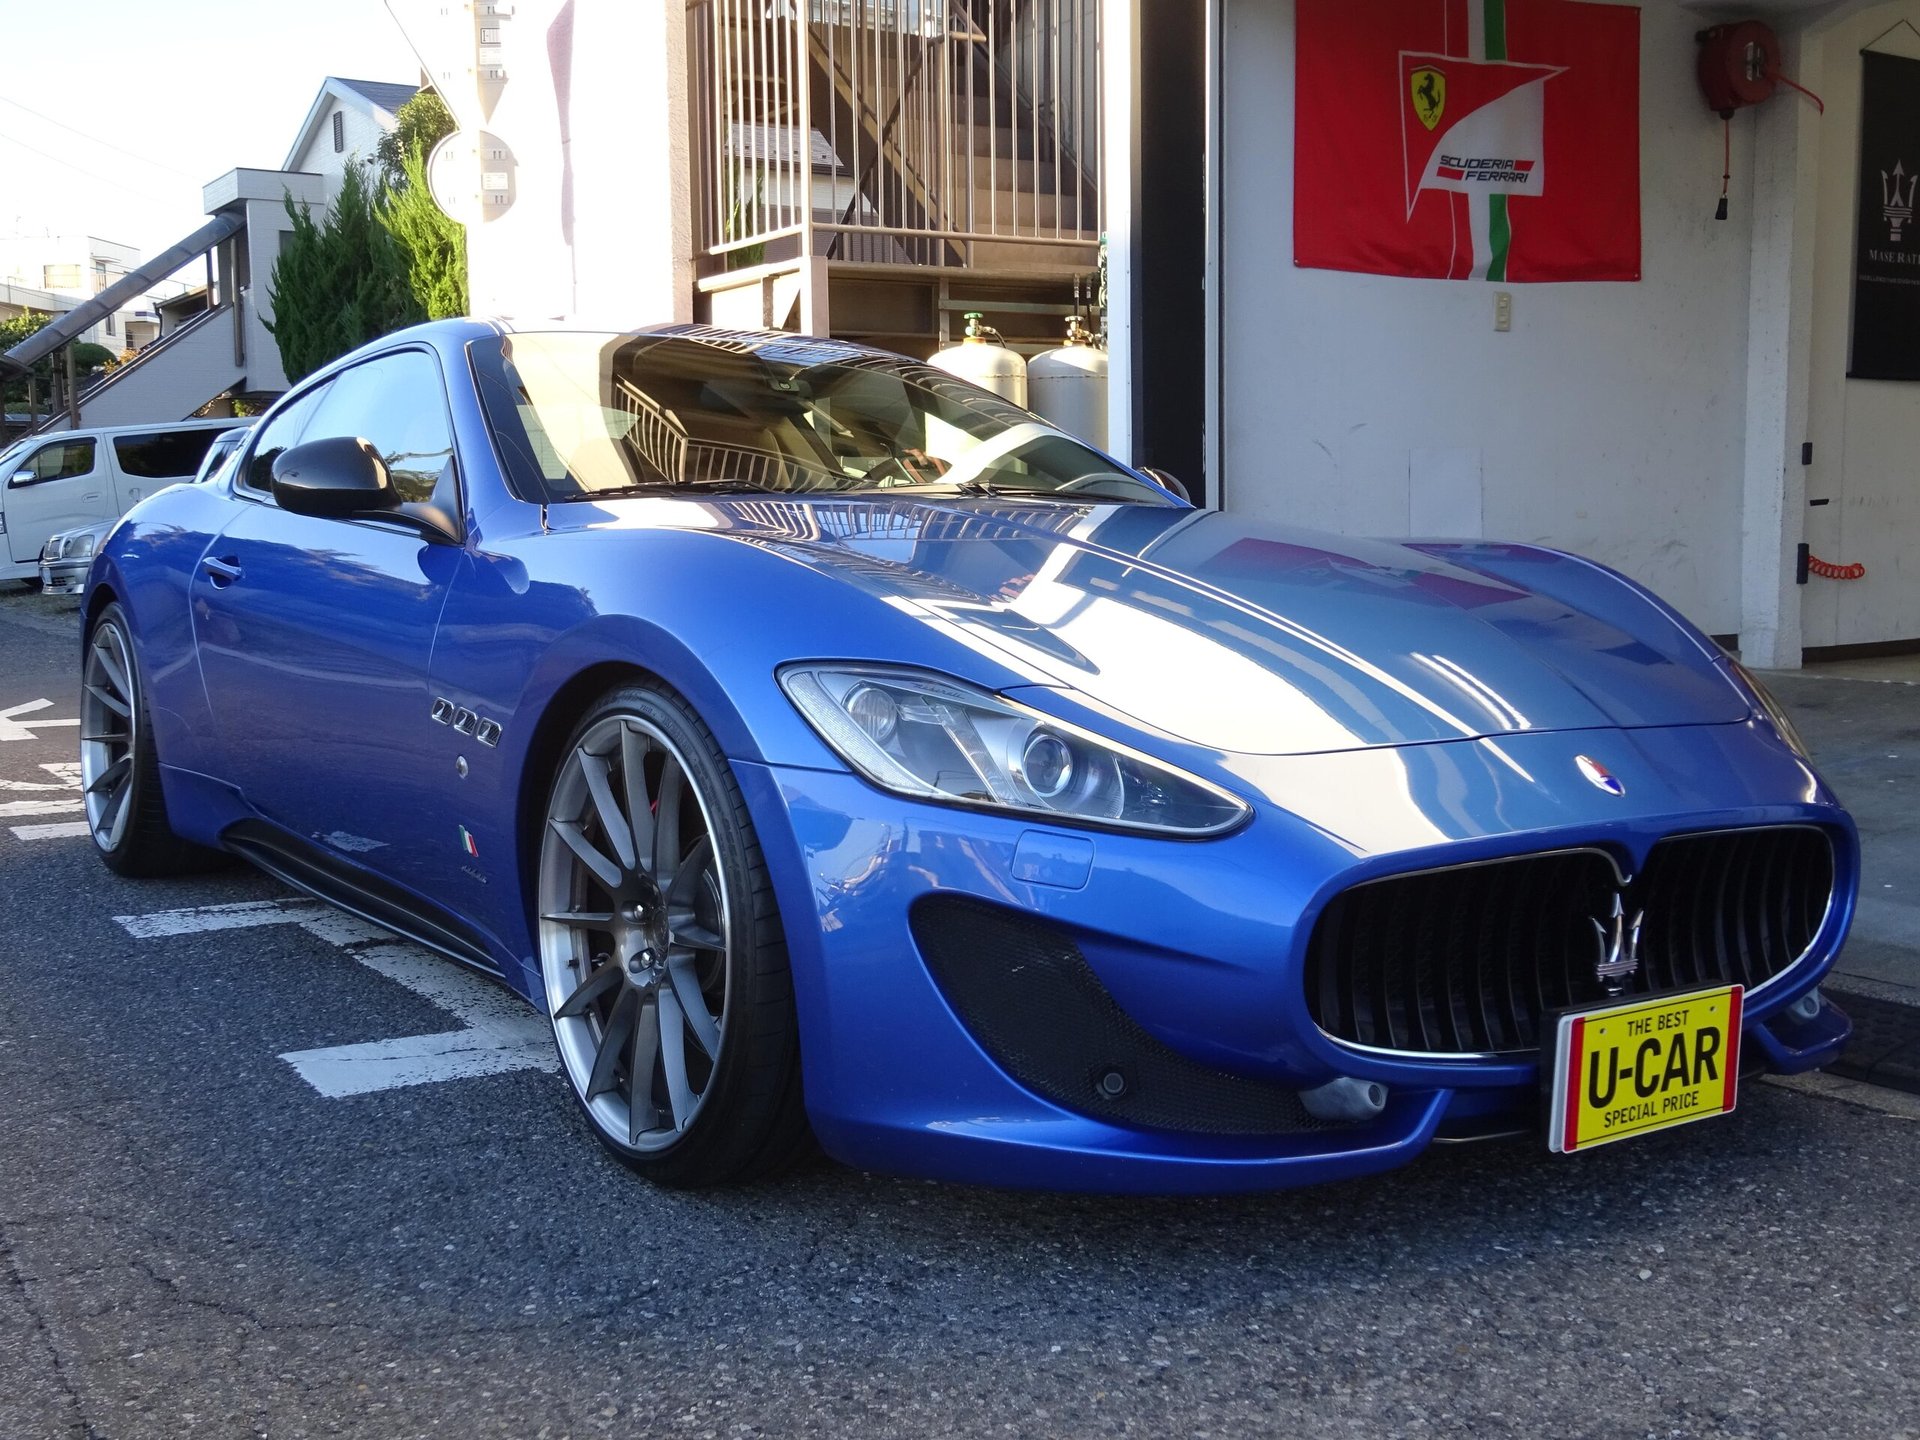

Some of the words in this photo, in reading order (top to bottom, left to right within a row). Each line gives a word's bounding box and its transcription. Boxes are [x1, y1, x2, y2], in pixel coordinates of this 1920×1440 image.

[1440, 155, 1514, 169] SCUDERIA
[1465, 171, 1529, 184] FERRARI
[1627, 1017, 1652, 1037] THE
[1658, 1010, 1690, 1031] BEST
[1588, 1026, 1721, 1109] U-CAR
[1604, 1102, 1658, 1129] SPECIAL
[1663, 1090, 1699, 1114] PRICE
